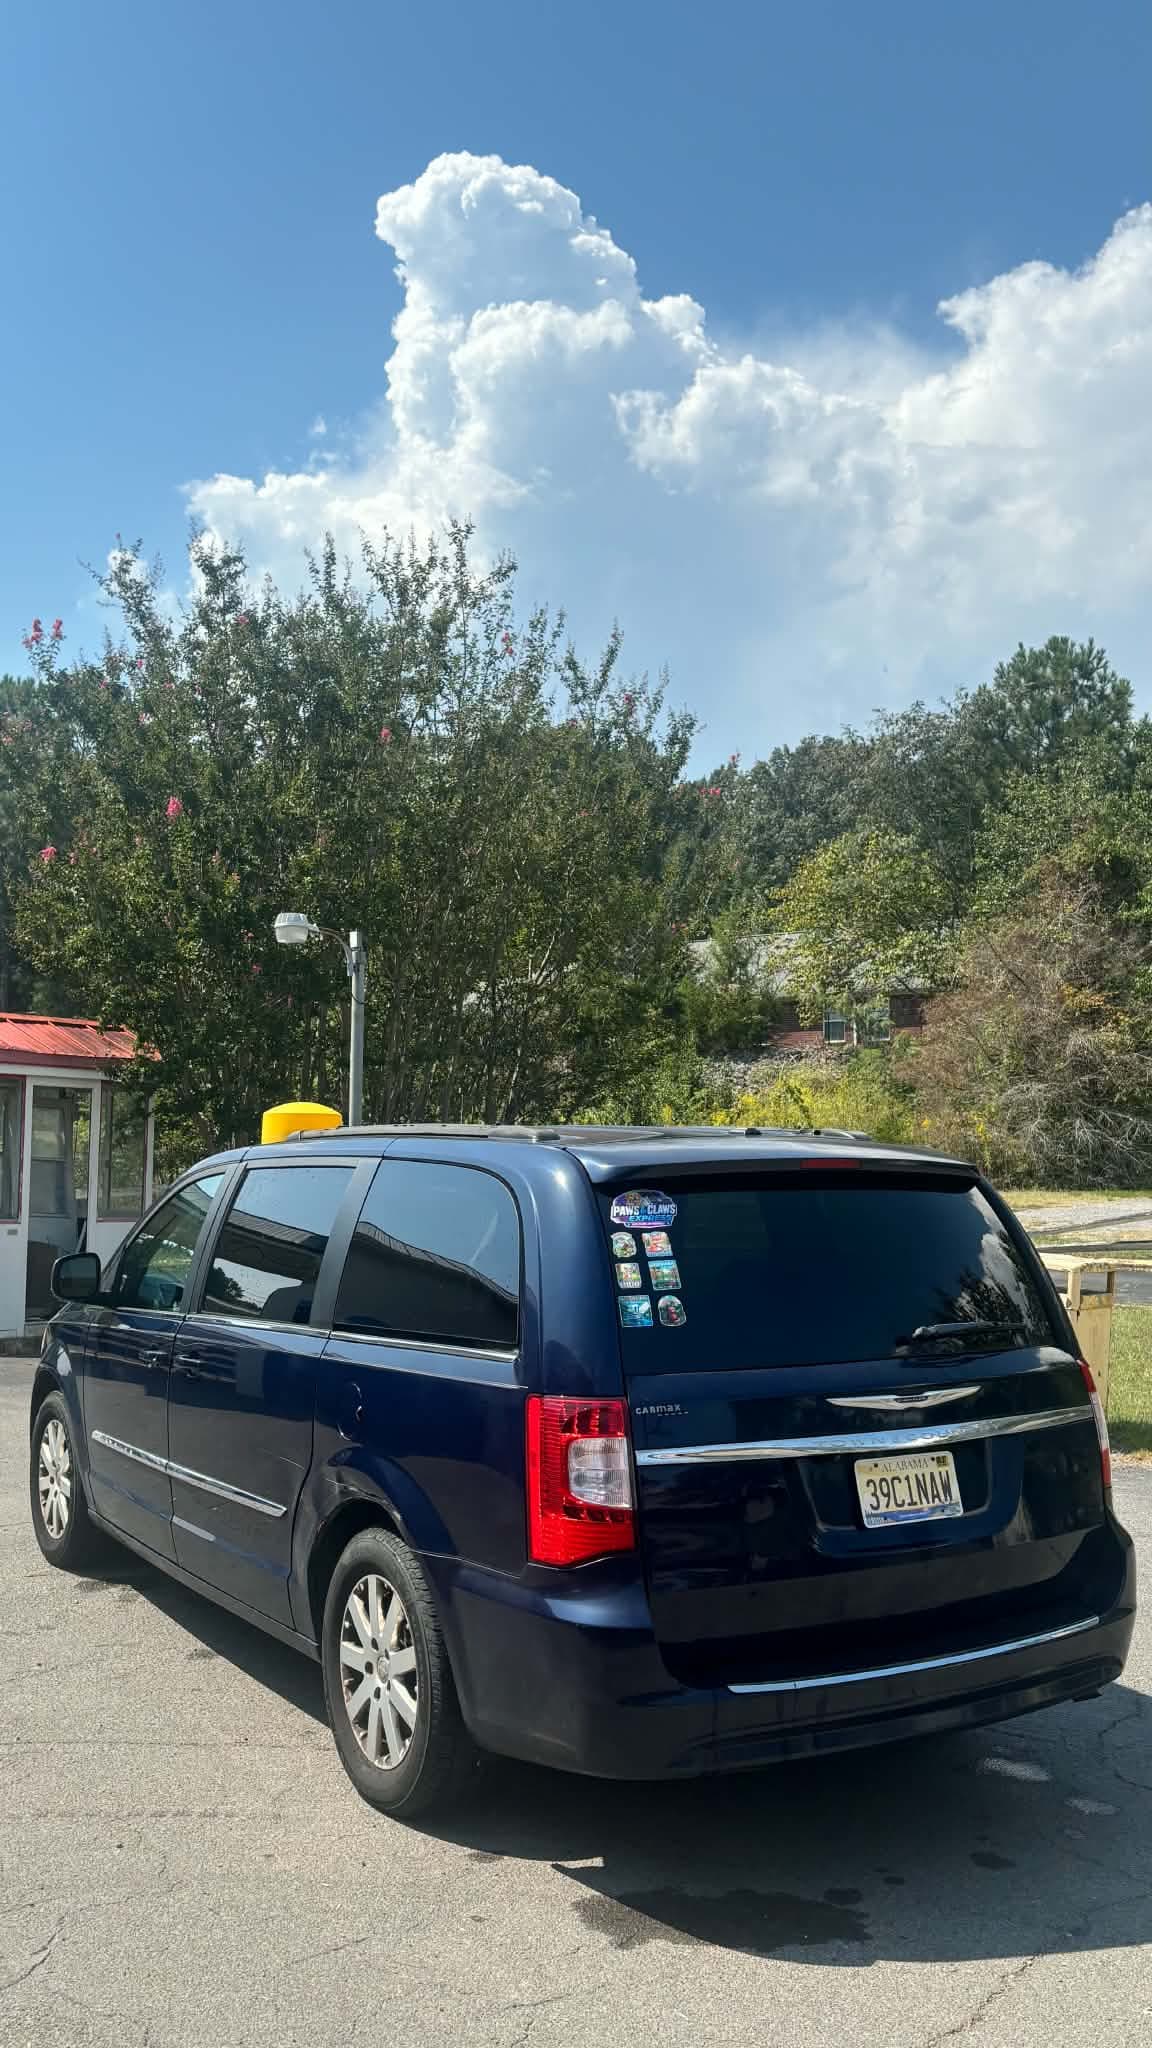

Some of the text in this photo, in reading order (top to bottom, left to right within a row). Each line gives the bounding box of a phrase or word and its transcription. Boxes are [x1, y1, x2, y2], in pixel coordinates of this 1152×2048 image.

[613, 1203, 675, 1217] PAWS CLAWS
[881, 1458, 929, 1473] ALABAMA
[866, 1470, 953, 1511] 39C1NAW
